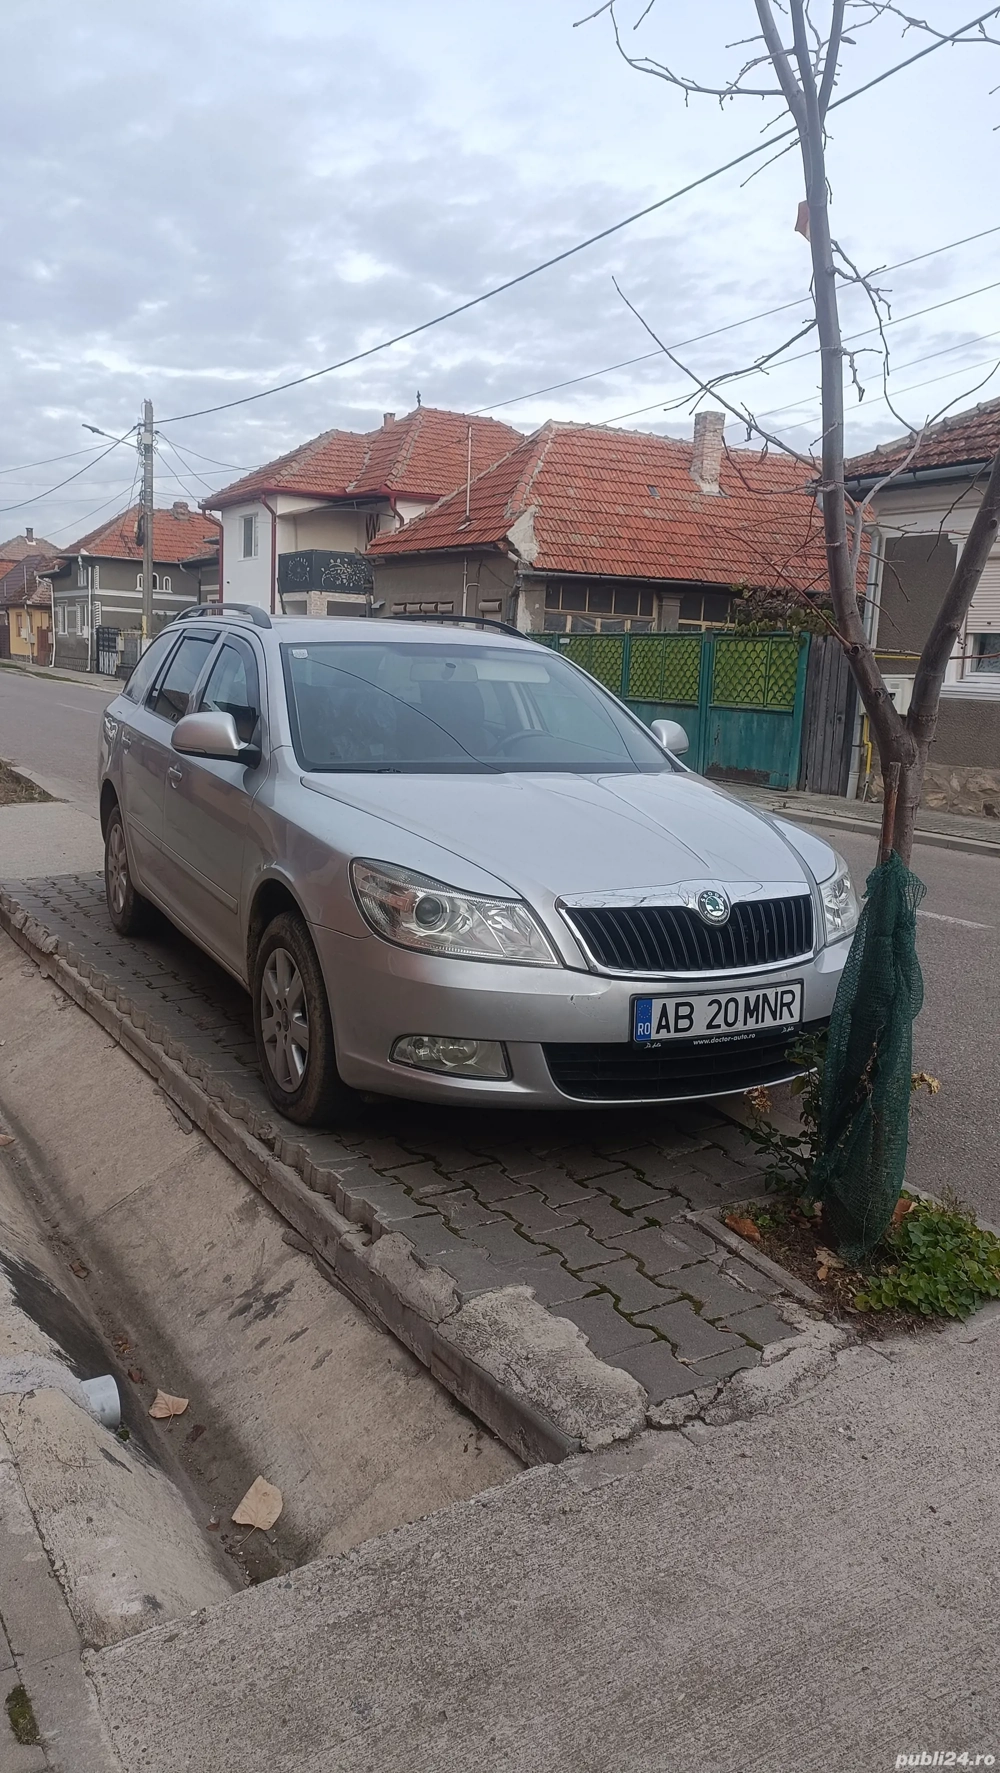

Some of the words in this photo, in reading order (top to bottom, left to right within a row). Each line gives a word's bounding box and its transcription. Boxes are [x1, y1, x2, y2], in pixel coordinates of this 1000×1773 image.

[655, 1001, 695, 1034] AB
[637, 1022, 651, 1036] RO
[693, 1033, 756, 1045] www.doctor-auto.ro
